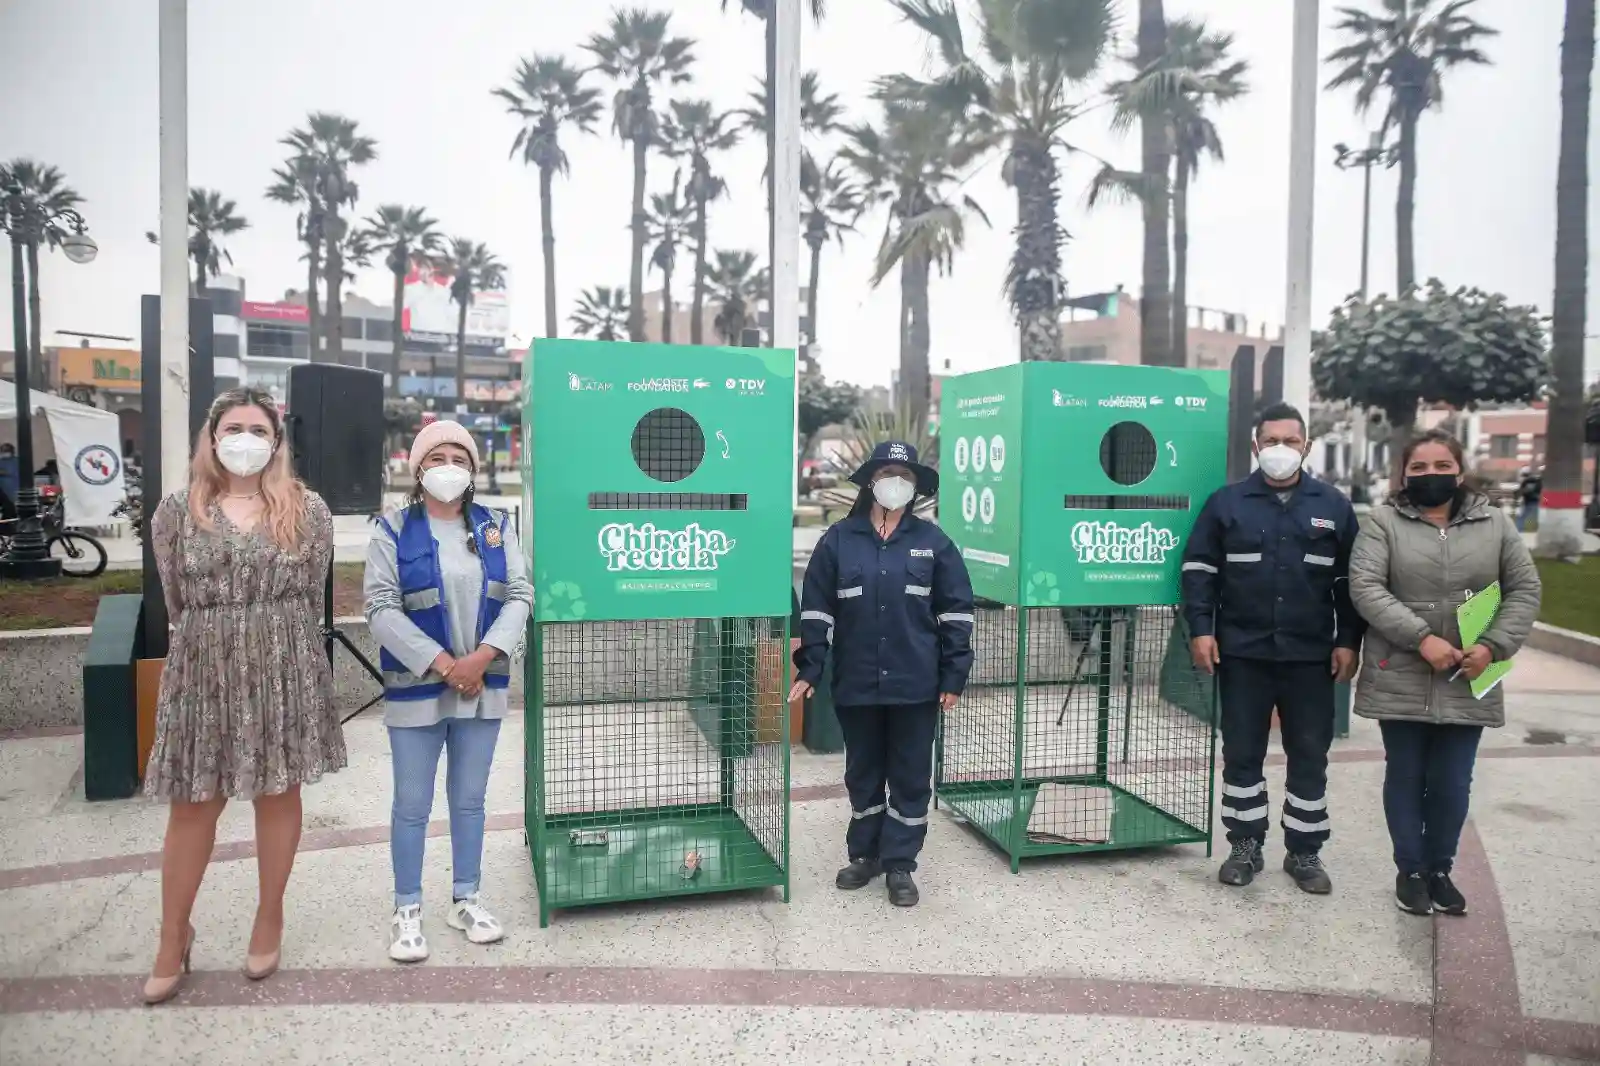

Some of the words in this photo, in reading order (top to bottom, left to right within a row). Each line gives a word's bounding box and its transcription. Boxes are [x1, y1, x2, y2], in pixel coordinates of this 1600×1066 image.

[627, 382, 690, 393] FOUNDATION
[642, 378, 689, 388] LACOSTE
[738, 379, 766, 390] TDV
[1185, 397, 1207, 407] TDV
[598, 522, 737, 556] Chincha
[1071, 521, 1180, 551] Chincha
[607, 550, 718, 571] recicla
[1078, 545, 1166, 564] recicla
